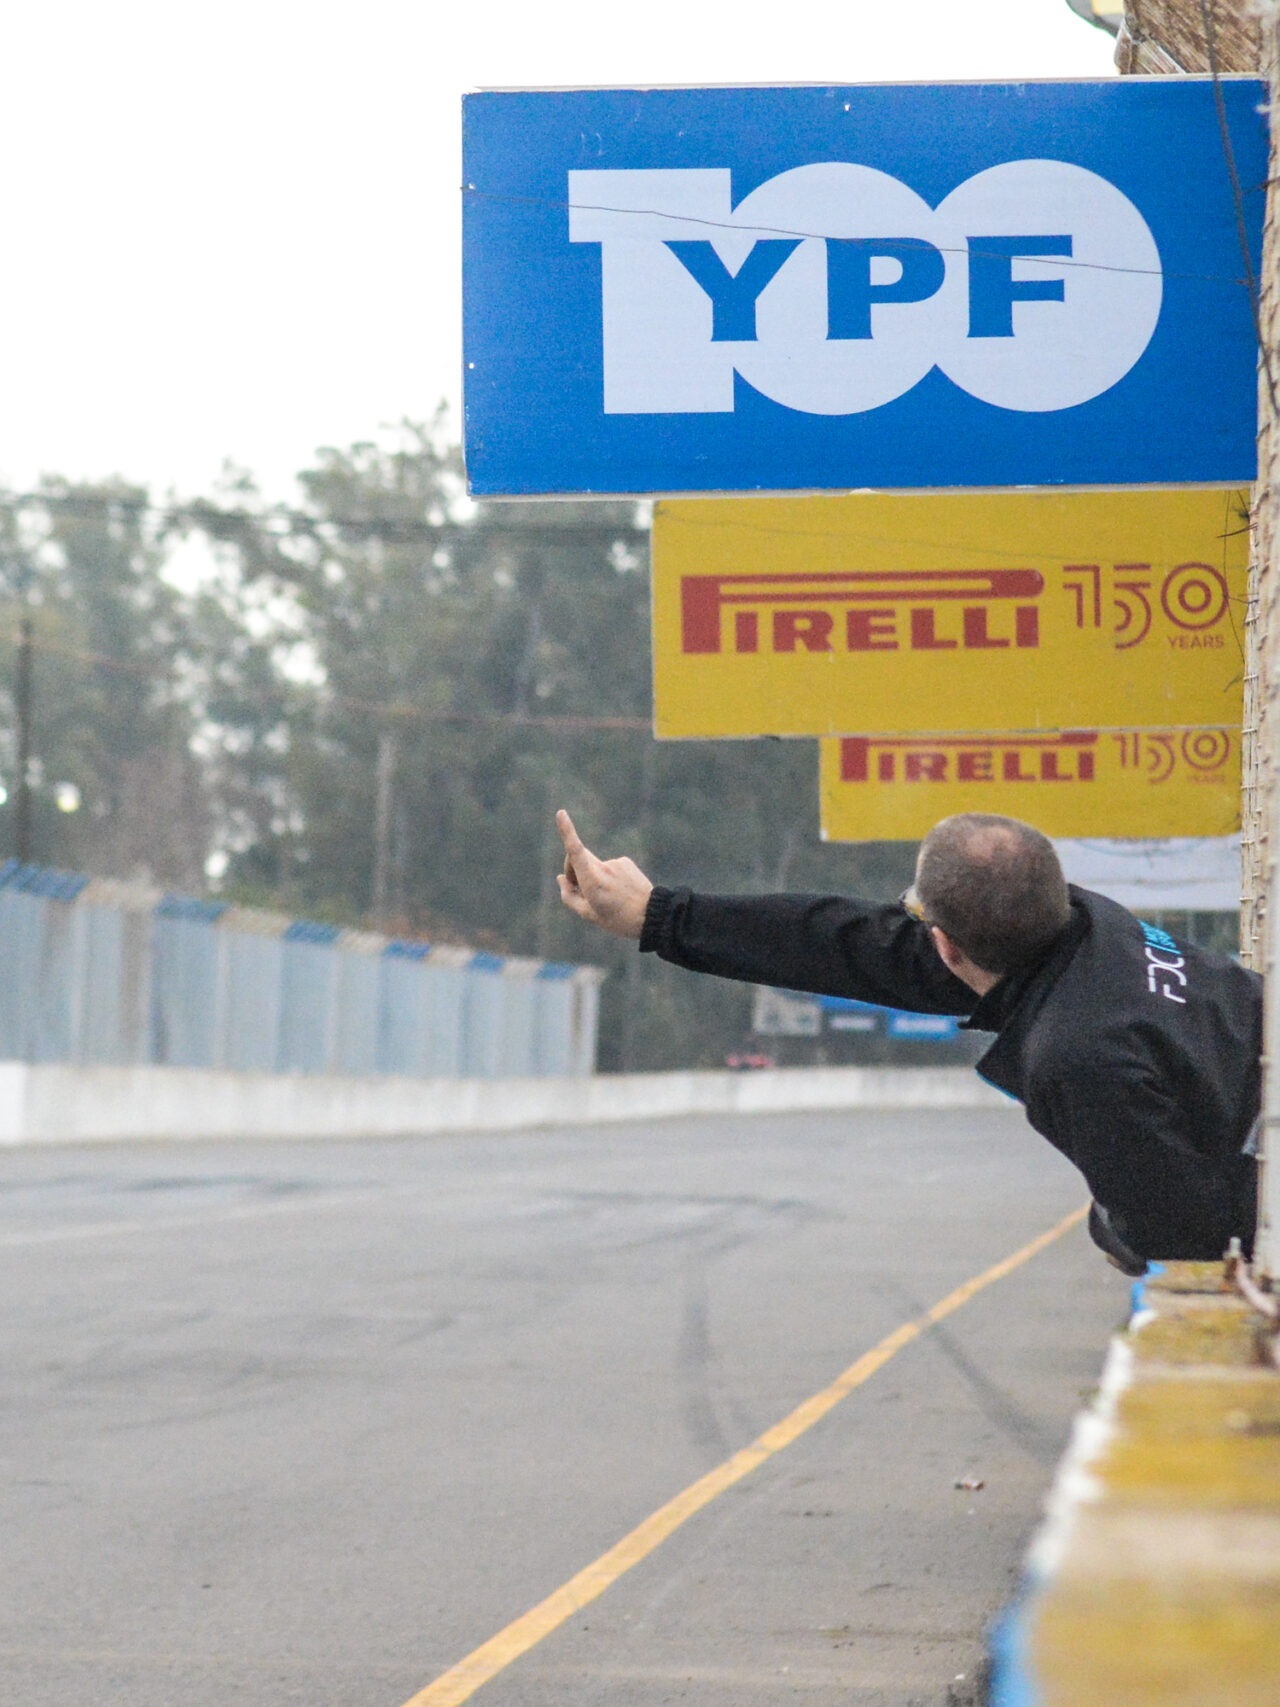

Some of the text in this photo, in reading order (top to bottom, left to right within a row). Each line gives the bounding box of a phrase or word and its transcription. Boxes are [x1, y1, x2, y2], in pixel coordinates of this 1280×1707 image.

[568, 159, 1162, 415] 100
[662, 235, 1072, 342] YPF
[681, 561, 1229, 654] PIRELLI 150
[1167, 634, 1225, 649] YEARS
[839, 731, 1098, 782] PIRELLI
